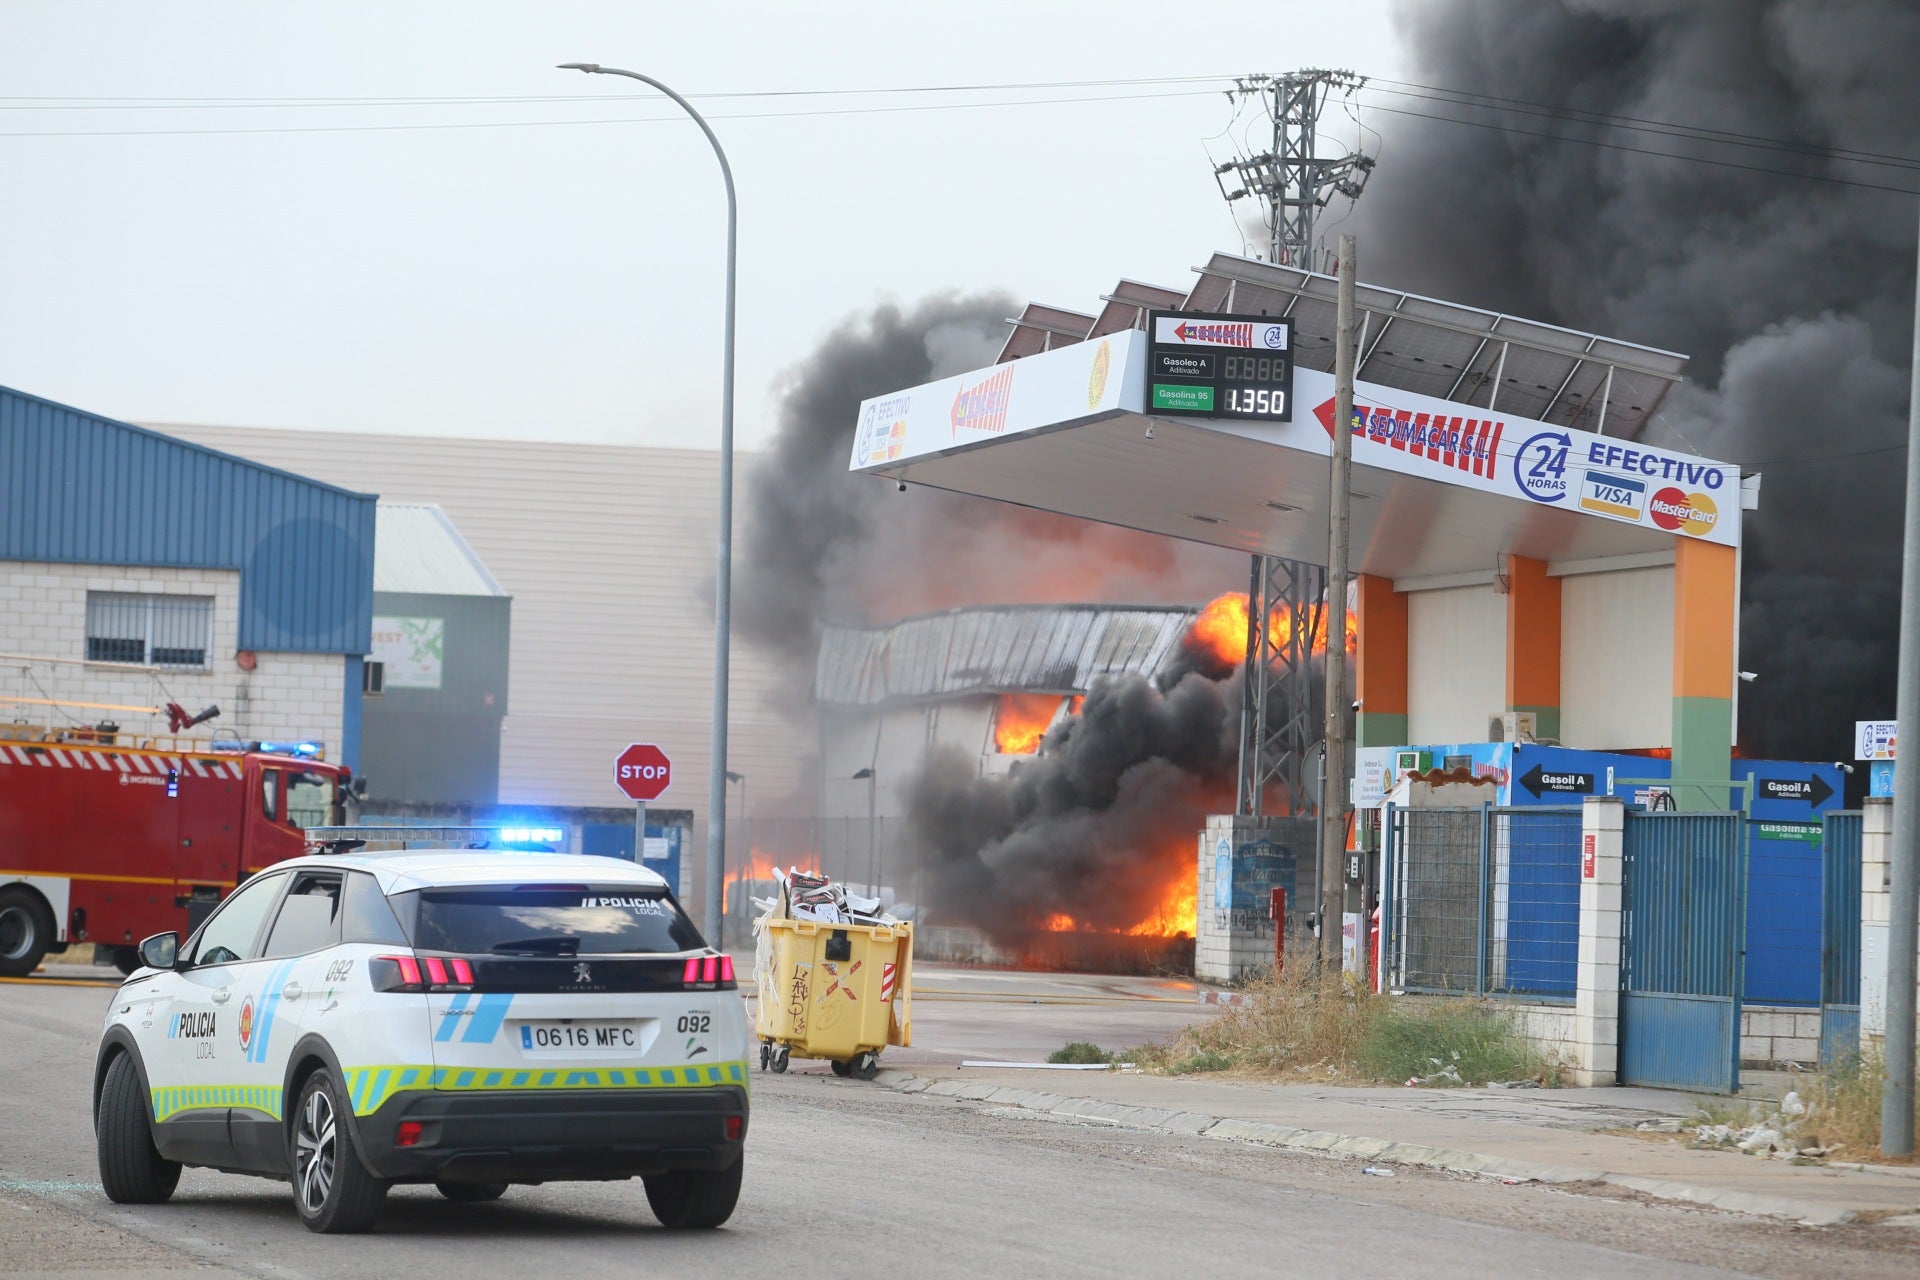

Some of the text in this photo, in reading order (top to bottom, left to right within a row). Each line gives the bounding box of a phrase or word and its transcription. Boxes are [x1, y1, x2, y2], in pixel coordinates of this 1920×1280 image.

[1269, 330, 1281, 342] 24
[1163, 357, 1206, 367] Gasoleo A
[1169, 367, 1200, 375] Aditivado
[1159, 389, 1208, 400] Gasolina 95
[1168, 399, 1199, 408] Aditivada
[1231, 389, 1285, 414] 1.350
[1528, 445, 1569, 479] 24
[1588, 442, 1724, 490] EFECTIVO
[1526, 478, 1567, 490] HORAS
[1593, 484, 1633, 506] VISA
[1651, 499, 1718, 525] MasterCard
[1876, 724, 1897, 735] EFECTIV
[621, 765, 667, 780] STOP
[1542, 775, 1585, 785] Gasoil A
[1768, 782, 1811, 793] Gasoil A
[599, 898, 660, 909] POLICIA
[634, 908, 665, 917] LOCAL
[179, 1012, 216, 1038] POLICIA
[677, 1015, 711, 1034] 092
[536, 1028, 634, 1046] 0616 MFC
[196, 1042, 216, 1059] LOCAL
